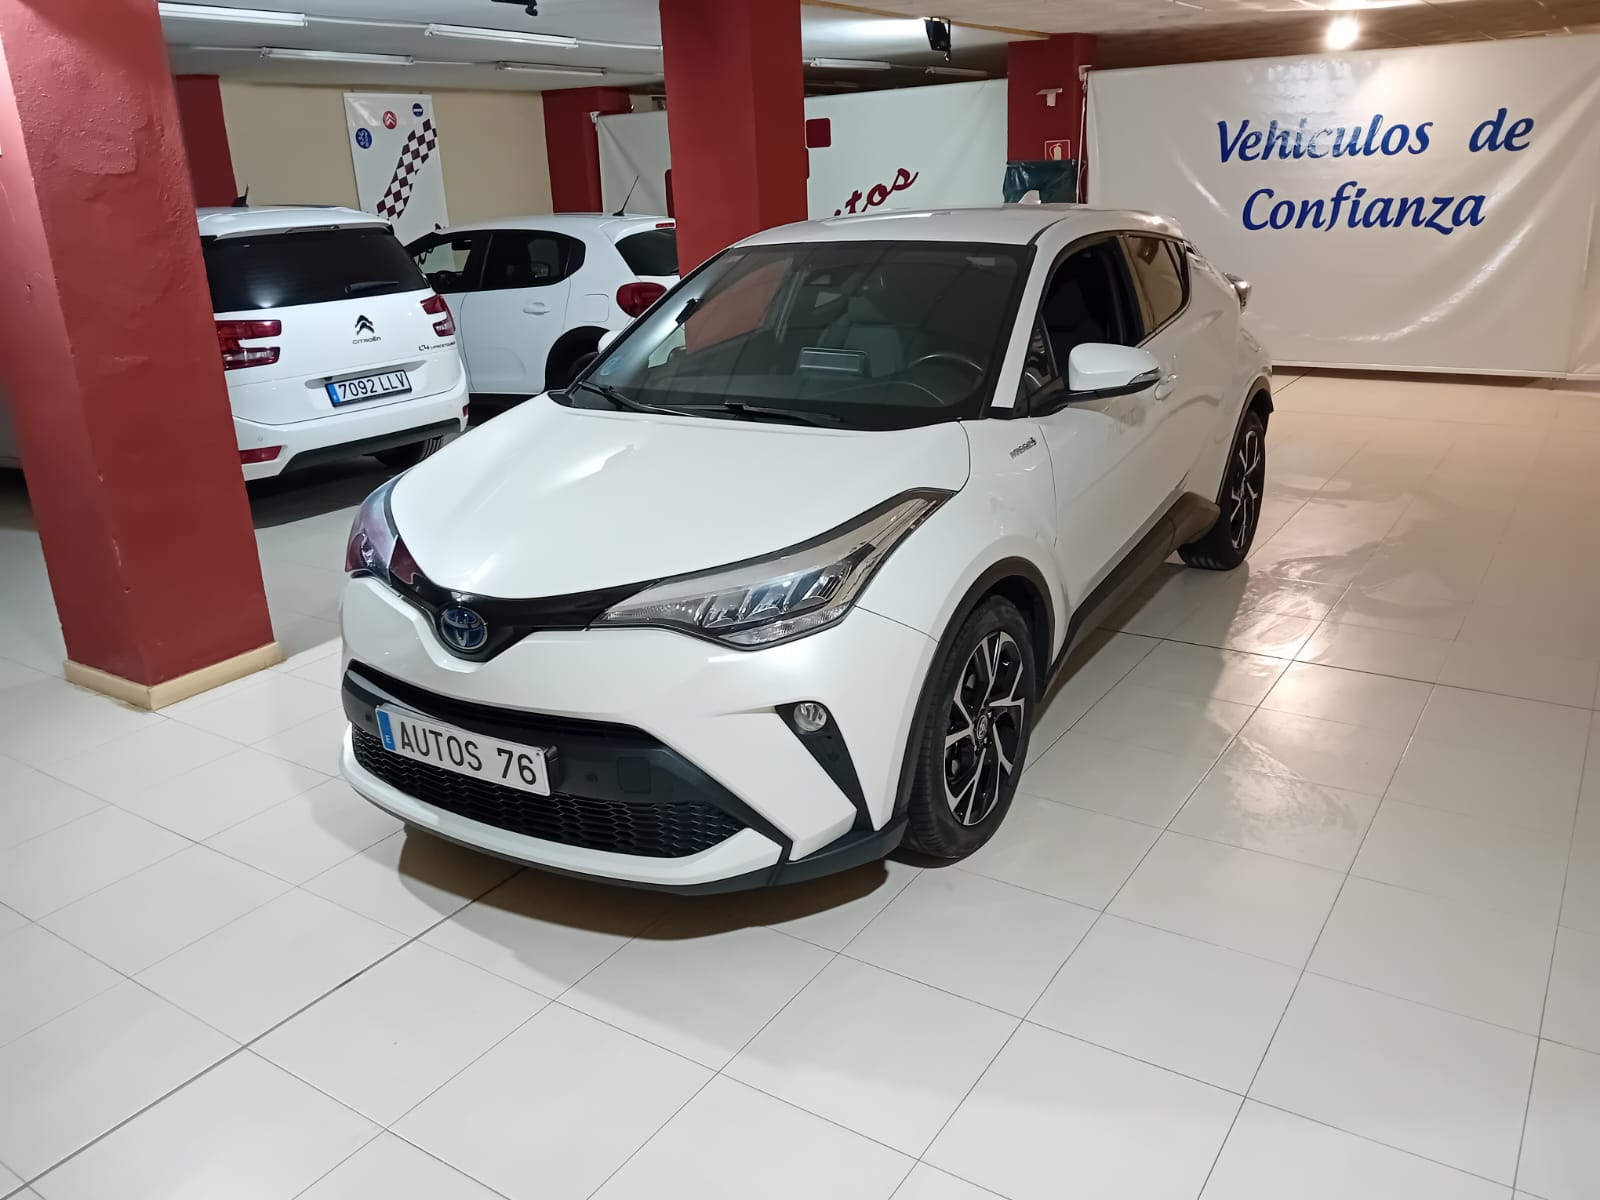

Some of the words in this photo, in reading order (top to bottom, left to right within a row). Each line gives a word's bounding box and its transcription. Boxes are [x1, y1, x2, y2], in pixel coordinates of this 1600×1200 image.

[1468, 107, 1534, 152] de
[1242, 181, 1486, 235] Confianza
[338, 379, 377, 399] 7092
[378, 373, 405, 391] LLV
[400, 721, 482, 771] AUTOS
[496, 747, 537, 785] 76
